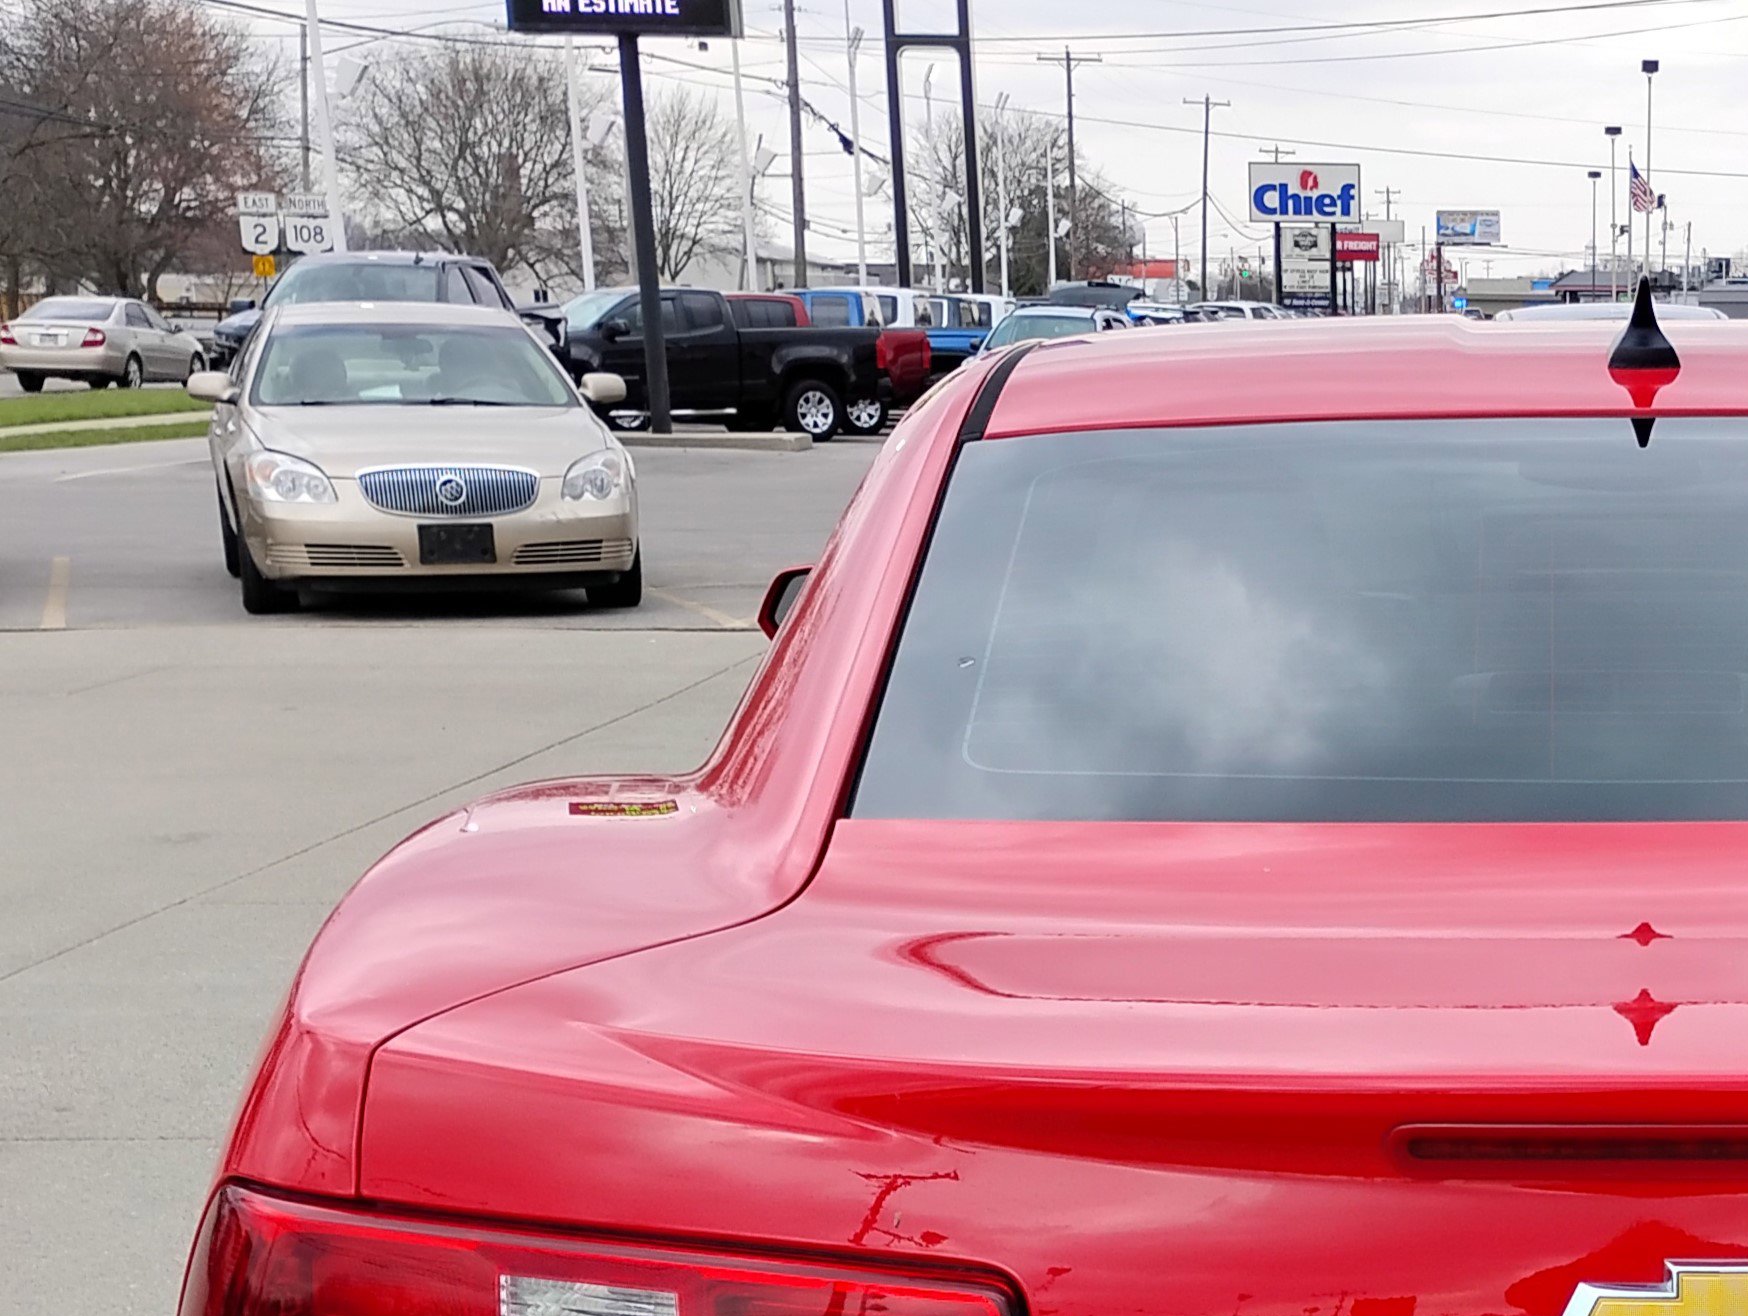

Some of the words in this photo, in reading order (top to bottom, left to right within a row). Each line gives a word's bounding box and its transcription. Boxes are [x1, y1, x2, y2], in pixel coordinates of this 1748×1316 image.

[578, 0, 679, 15] ESTIMATE
[243, 196, 269, 209] EAST
[288, 197, 324, 210] NORTH
[1253, 182, 1356, 217] Chief
[253, 223, 269, 245] 2
[292, 224, 325, 244] 108
[1343, 240, 1378, 252] FREIGHT
